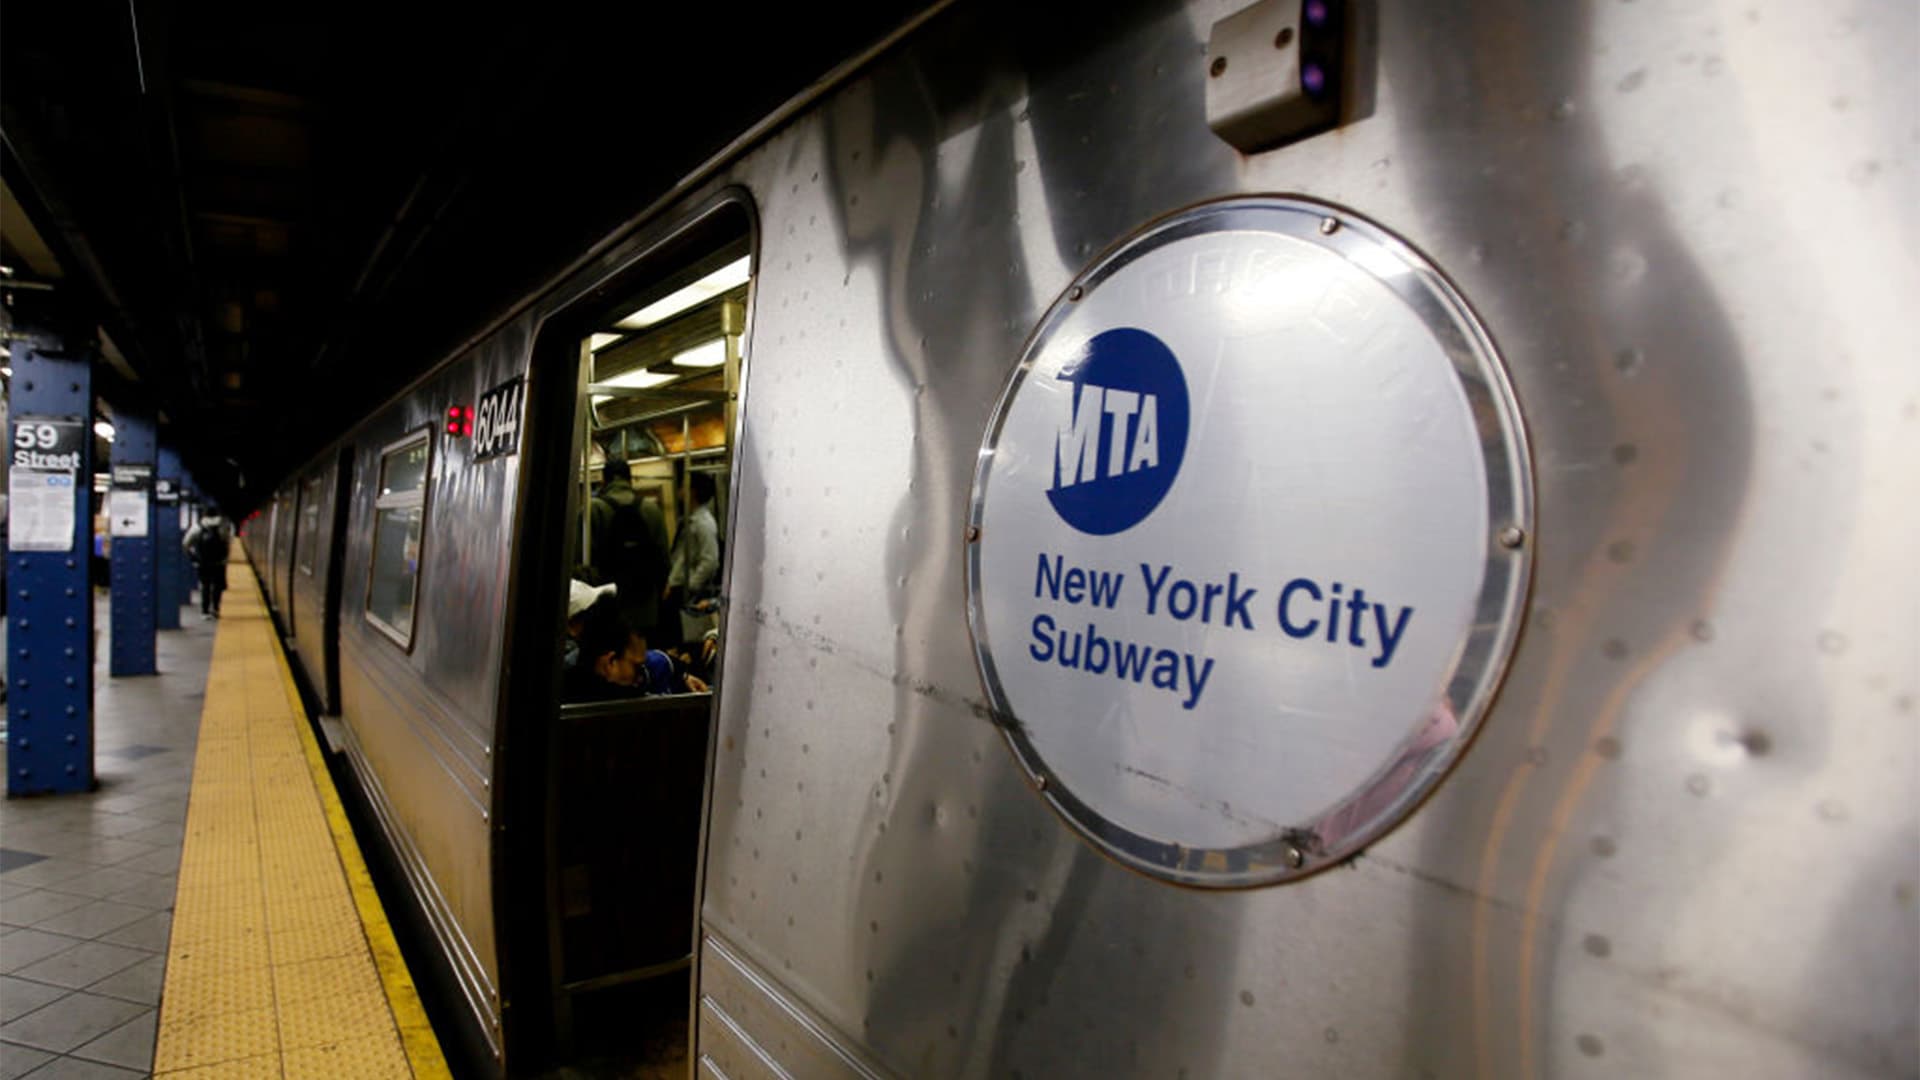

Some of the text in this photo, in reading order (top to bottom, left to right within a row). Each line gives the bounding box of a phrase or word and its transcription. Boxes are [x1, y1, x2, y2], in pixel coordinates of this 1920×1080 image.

[14, 424, 58, 449] 59
[14, 450, 80, 468] Street
[477, 384, 519, 454] 6044
[1055, 379, 1159, 490] MTA
[1035, 553, 1413, 668] New York City
[1029, 614, 1214, 710] Subway
